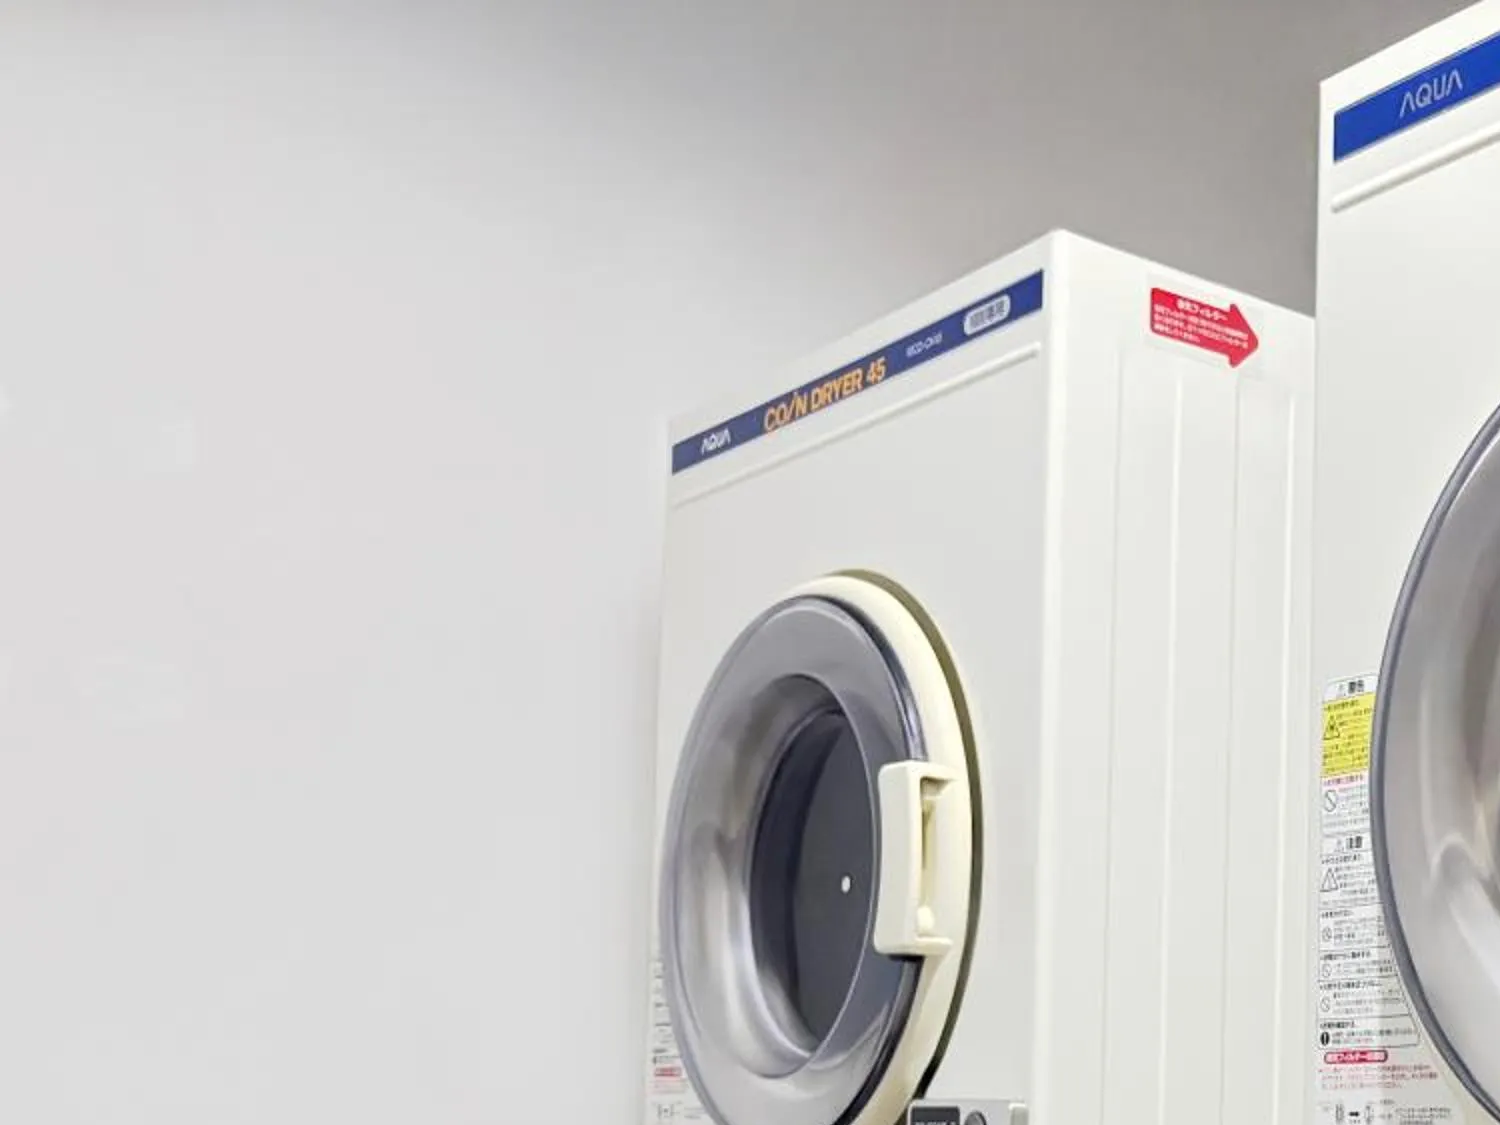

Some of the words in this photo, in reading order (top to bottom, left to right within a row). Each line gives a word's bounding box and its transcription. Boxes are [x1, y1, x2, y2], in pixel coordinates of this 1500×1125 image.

[1400, 69, 1463, 118] AQUA
[702, 428, 731, 454] AQUA
[811, 368, 864, 411] DRYER
[866, 356, 886, 384] 45
